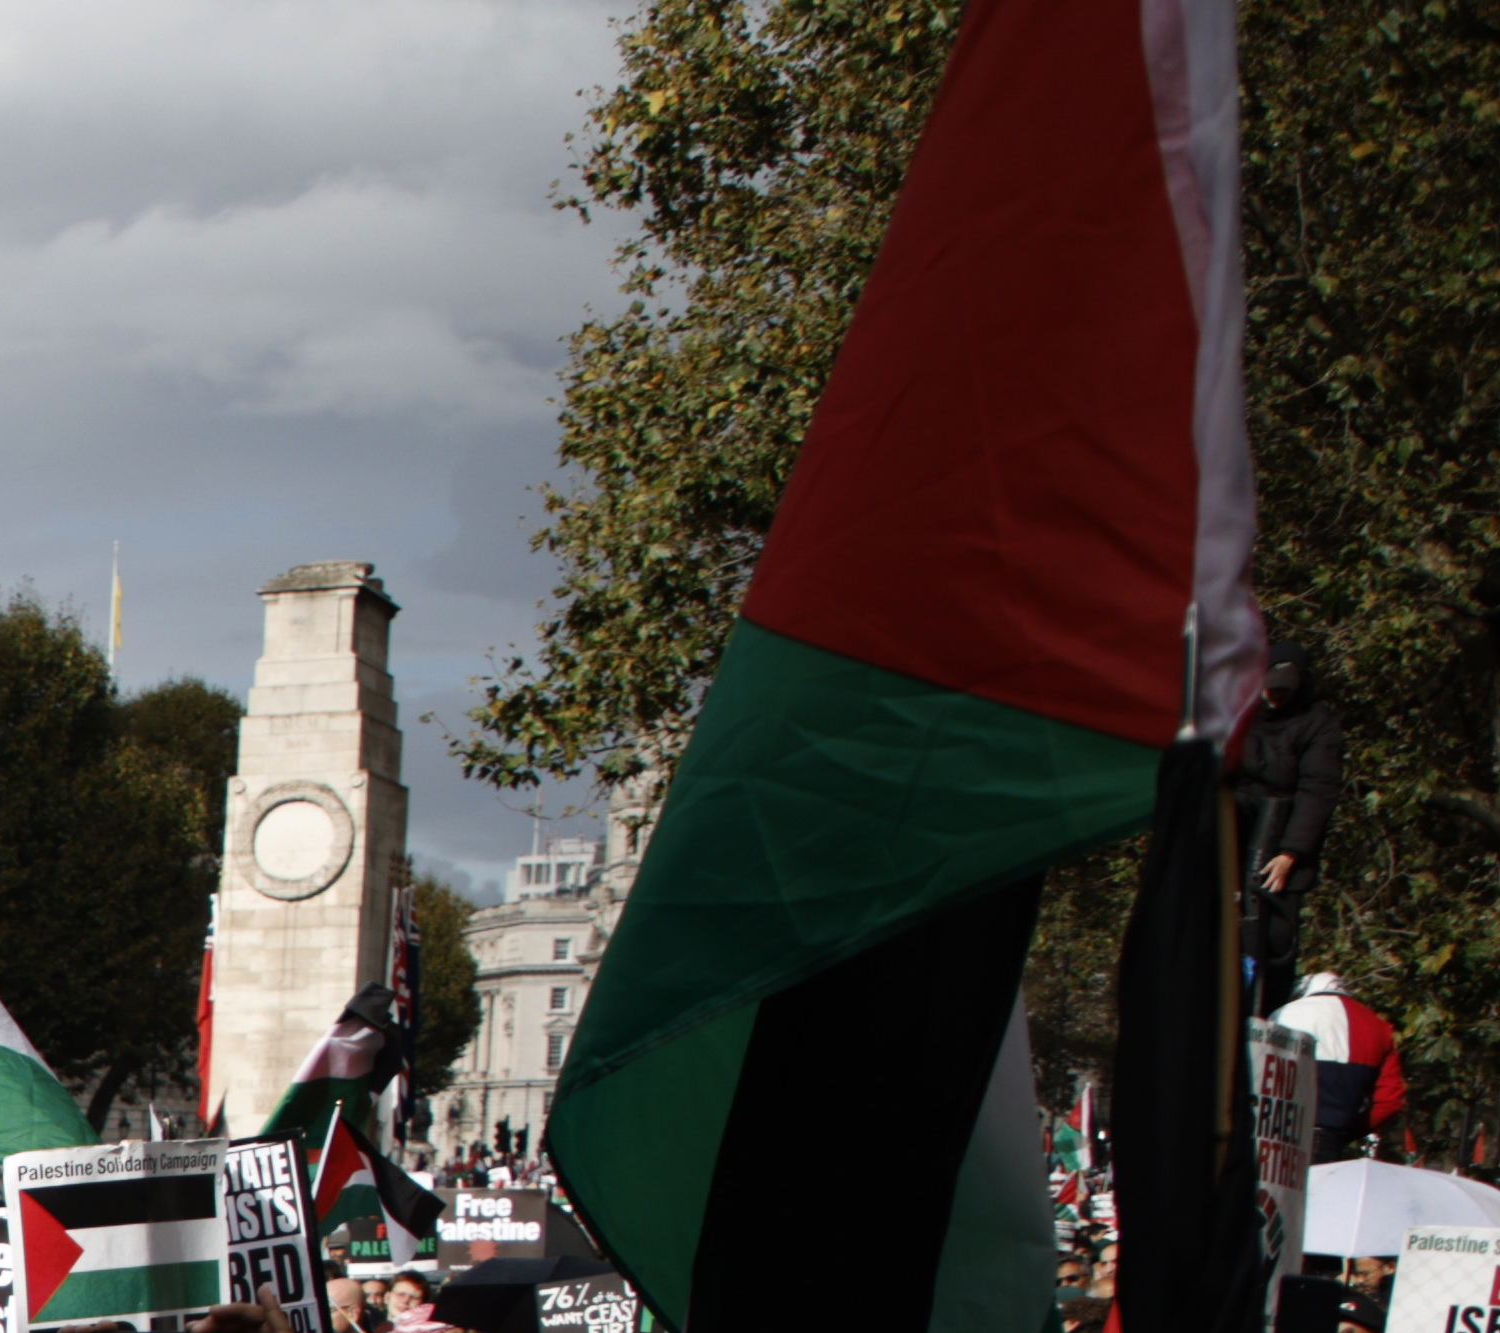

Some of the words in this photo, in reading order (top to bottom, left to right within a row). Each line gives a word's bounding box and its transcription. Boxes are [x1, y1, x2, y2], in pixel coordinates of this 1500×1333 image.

[1263, 1054, 1298, 1099] END
[17, 1161, 93, 1182] Palestine
[97, 1153, 158, 1175] Solidarity
[160, 1150, 218, 1173] Campaign
[455, 1193, 513, 1218] Free
[1408, 1233, 1490, 1257] Palestine
[538, 1282, 590, 1311] 76%
[541, 1311, 584, 1327] WANT
